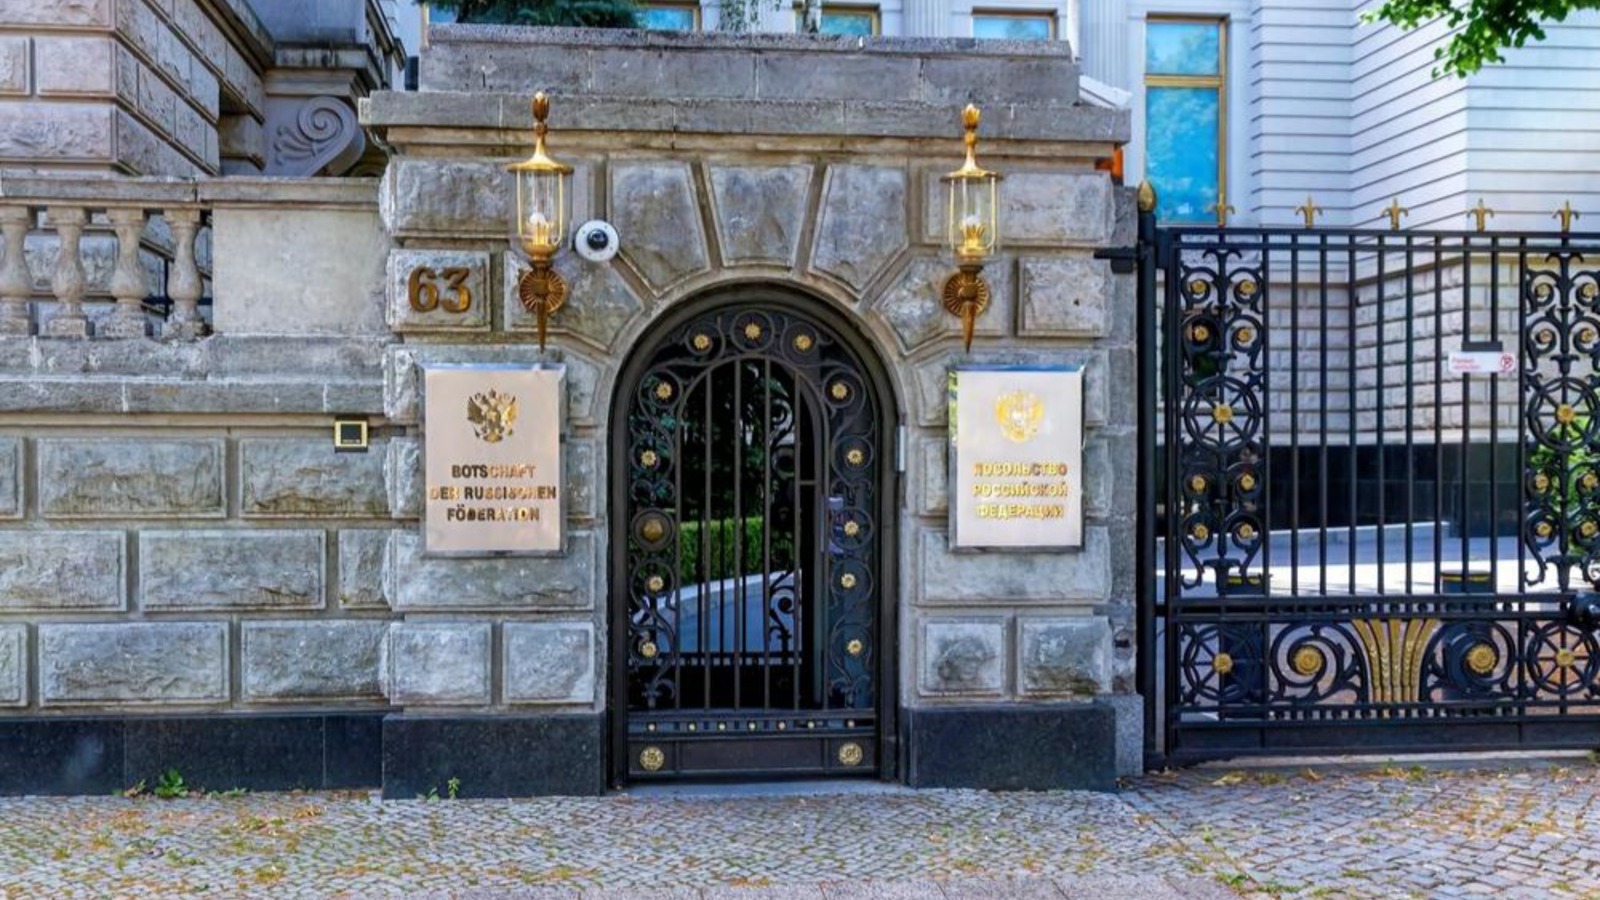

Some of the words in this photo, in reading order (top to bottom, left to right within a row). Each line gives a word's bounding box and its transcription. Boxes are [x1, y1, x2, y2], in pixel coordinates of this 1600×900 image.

[408, 265, 471, 313] 63
[452, 464, 536, 478] BOTSCHAFT
[973, 463, 1068, 476] ПОСОЛЬСТВО
[430, 486, 460, 500] DER
[464, 486, 556, 500] RUSSISCHEN
[972, 481, 1068, 497] РОССИЙСКОЙ
[976, 504, 1064, 519] ФЕДЕРАЦИИ
